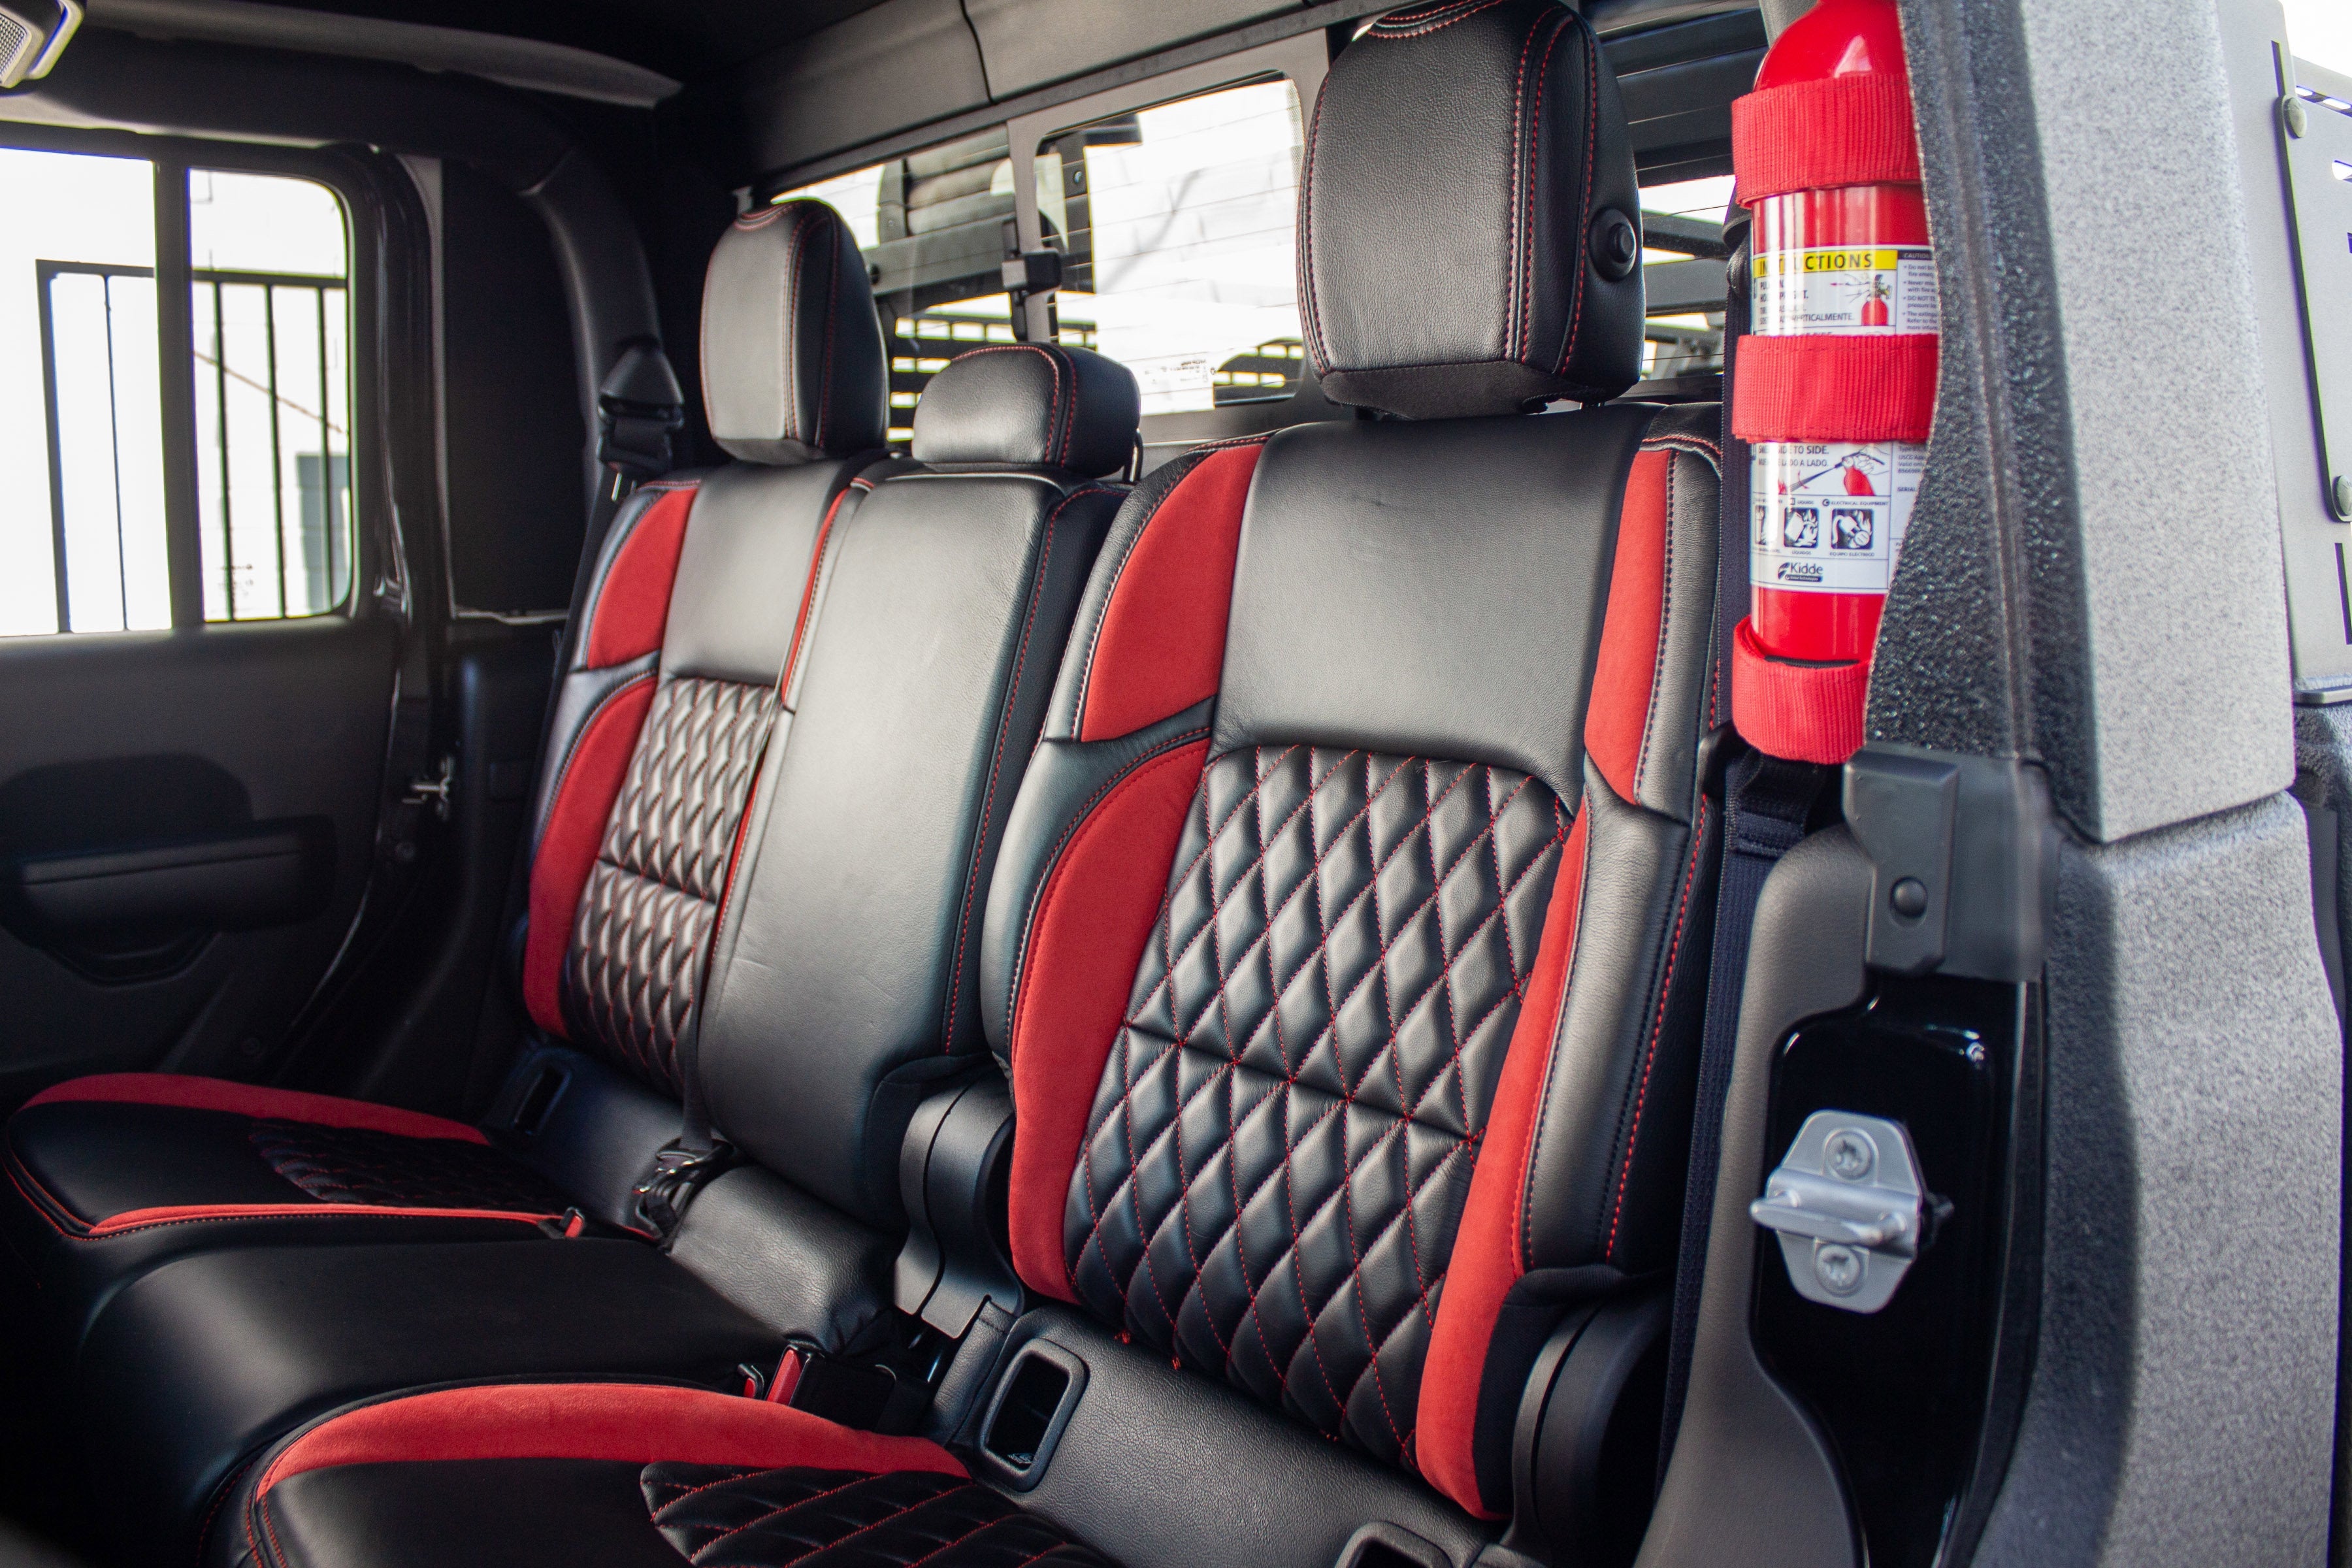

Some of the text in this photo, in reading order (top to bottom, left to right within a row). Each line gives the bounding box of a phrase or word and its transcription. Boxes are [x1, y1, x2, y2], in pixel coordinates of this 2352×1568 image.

[1793, 446, 1805, 455] TO
[1806, 445, 1829, 455] SIDE.
[1790, 562, 1823, 575] Kidde
